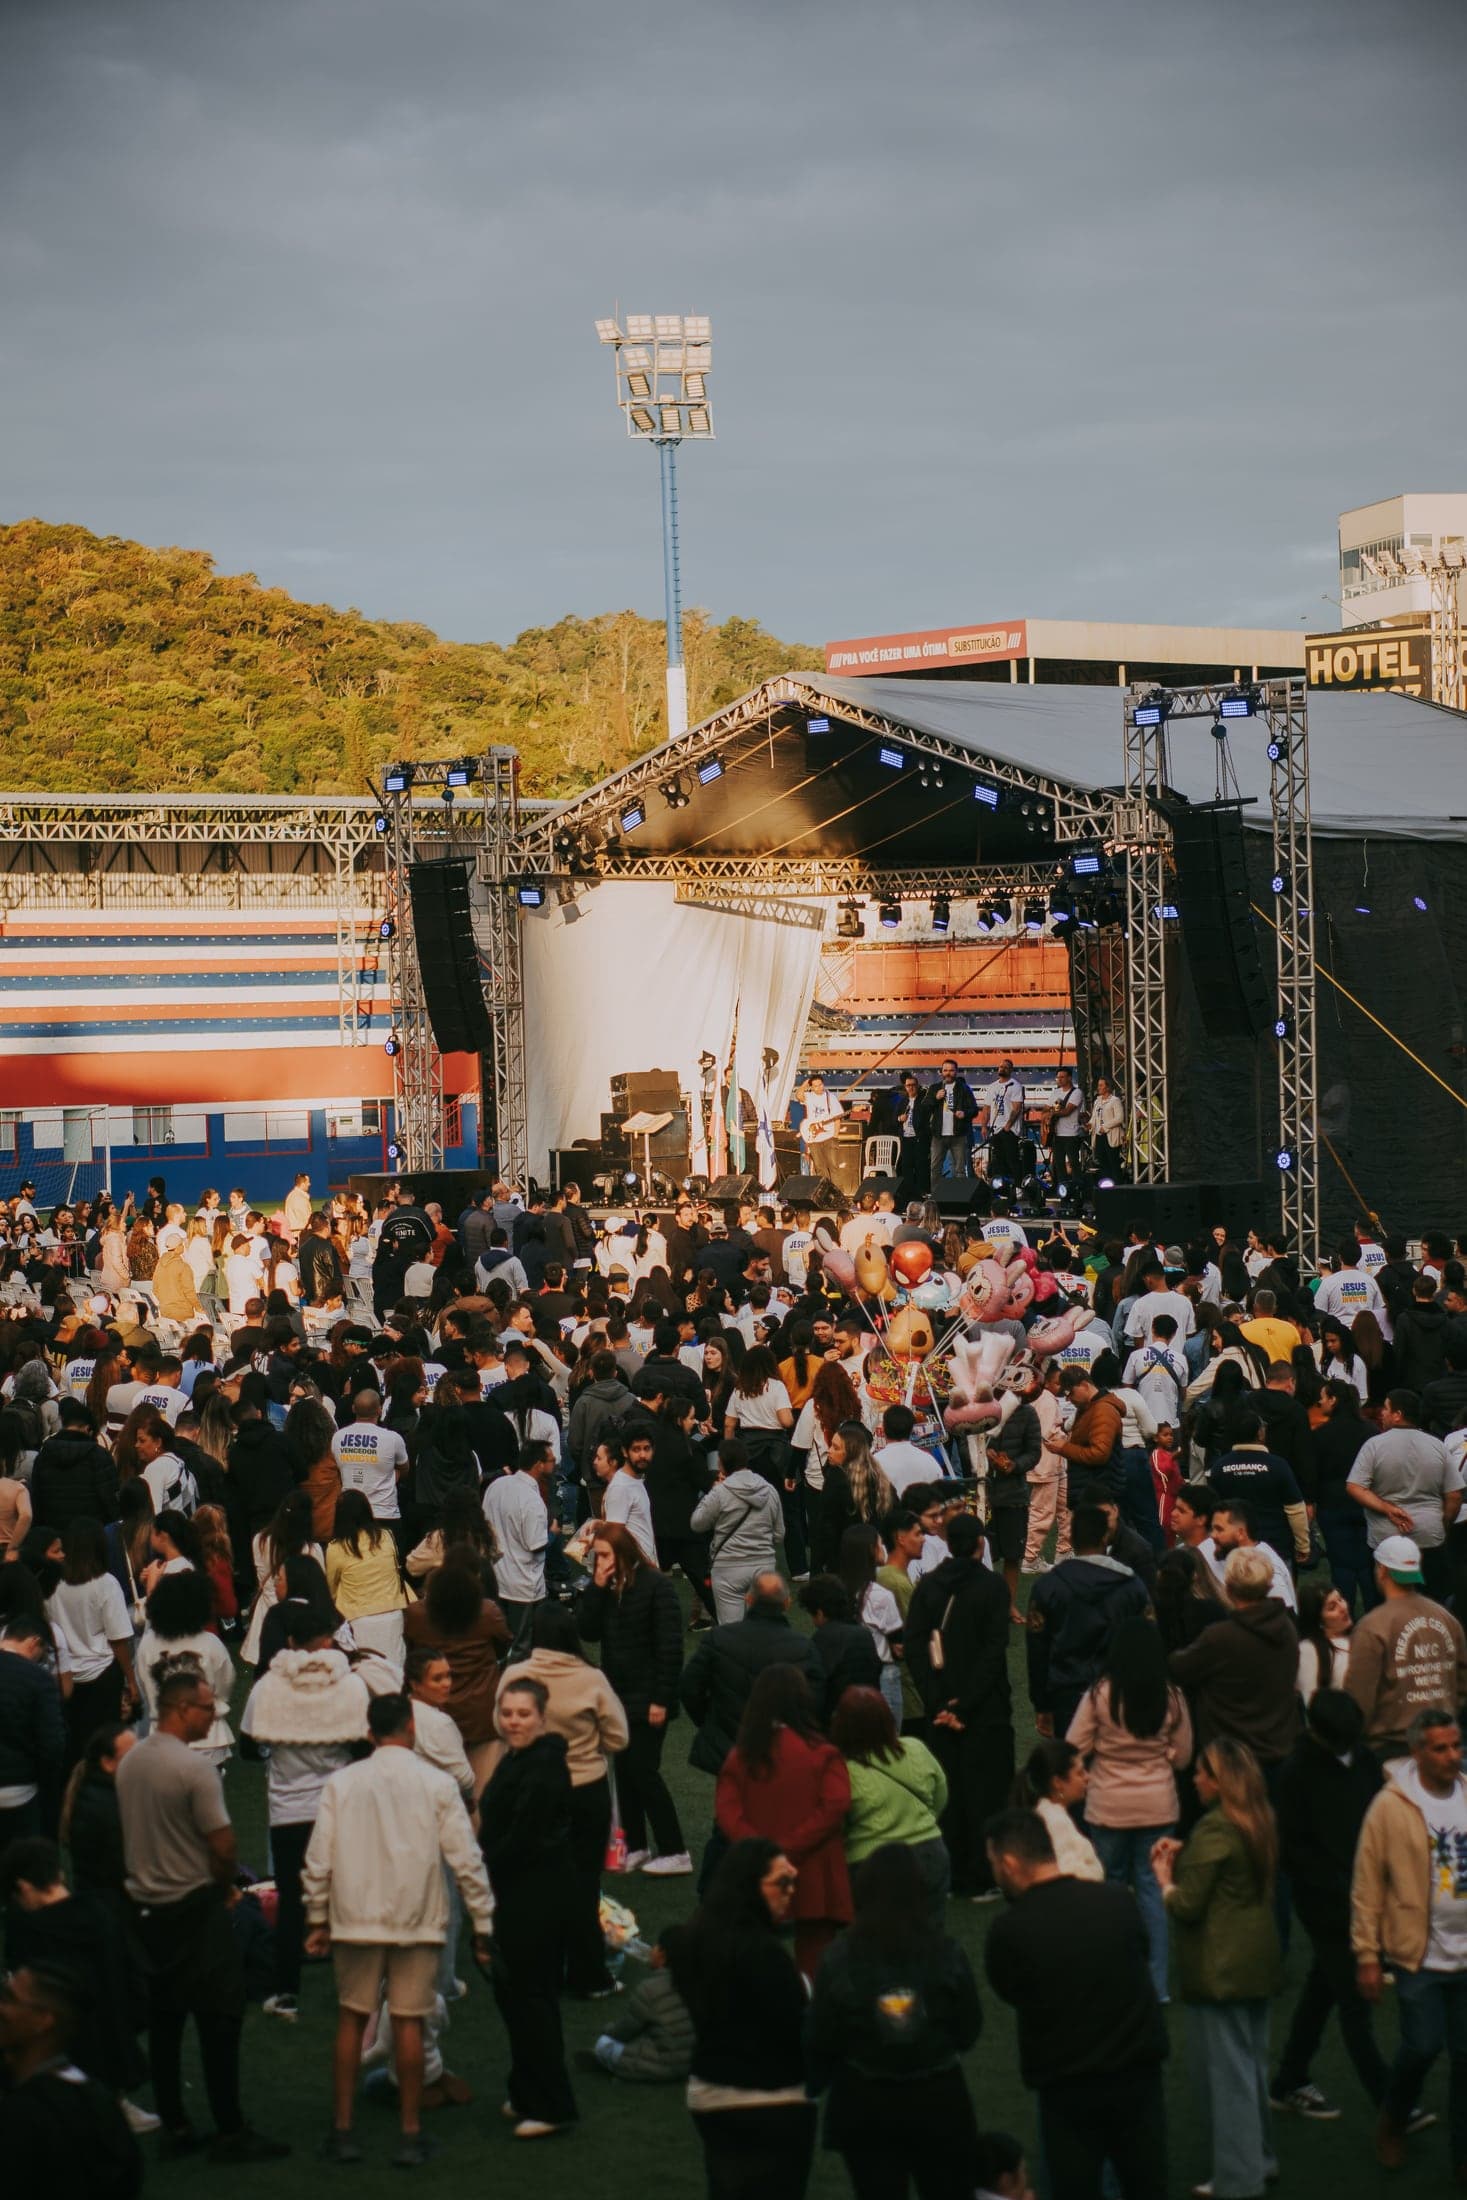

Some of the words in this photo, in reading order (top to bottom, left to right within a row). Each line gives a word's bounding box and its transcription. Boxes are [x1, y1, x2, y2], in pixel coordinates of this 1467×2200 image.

[842, 652, 858, 666] PRA
[859, 648, 878, 663] VOCÊ
[879, 647, 902, 662] FAZER
[903, 645, 921, 659] UMA
[922, 641, 947, 657] ÓTIMA
[954, 634, 1001, 653] SUBSTITUIÇÃO
[1310, 641, 1420, 685] HOTEL
[988, 1225, 1010, 1234] JESUS
[1365, 1252, 1384, 1262] JESUS
[1340, 1282, 1367, 1291] JESUS
[1061, 1347, 1091, 1357] JESUS
[340, 1434, 378, 1448] JESUS
[1222, 1463, 1269, 1473] SEGURANÇA
